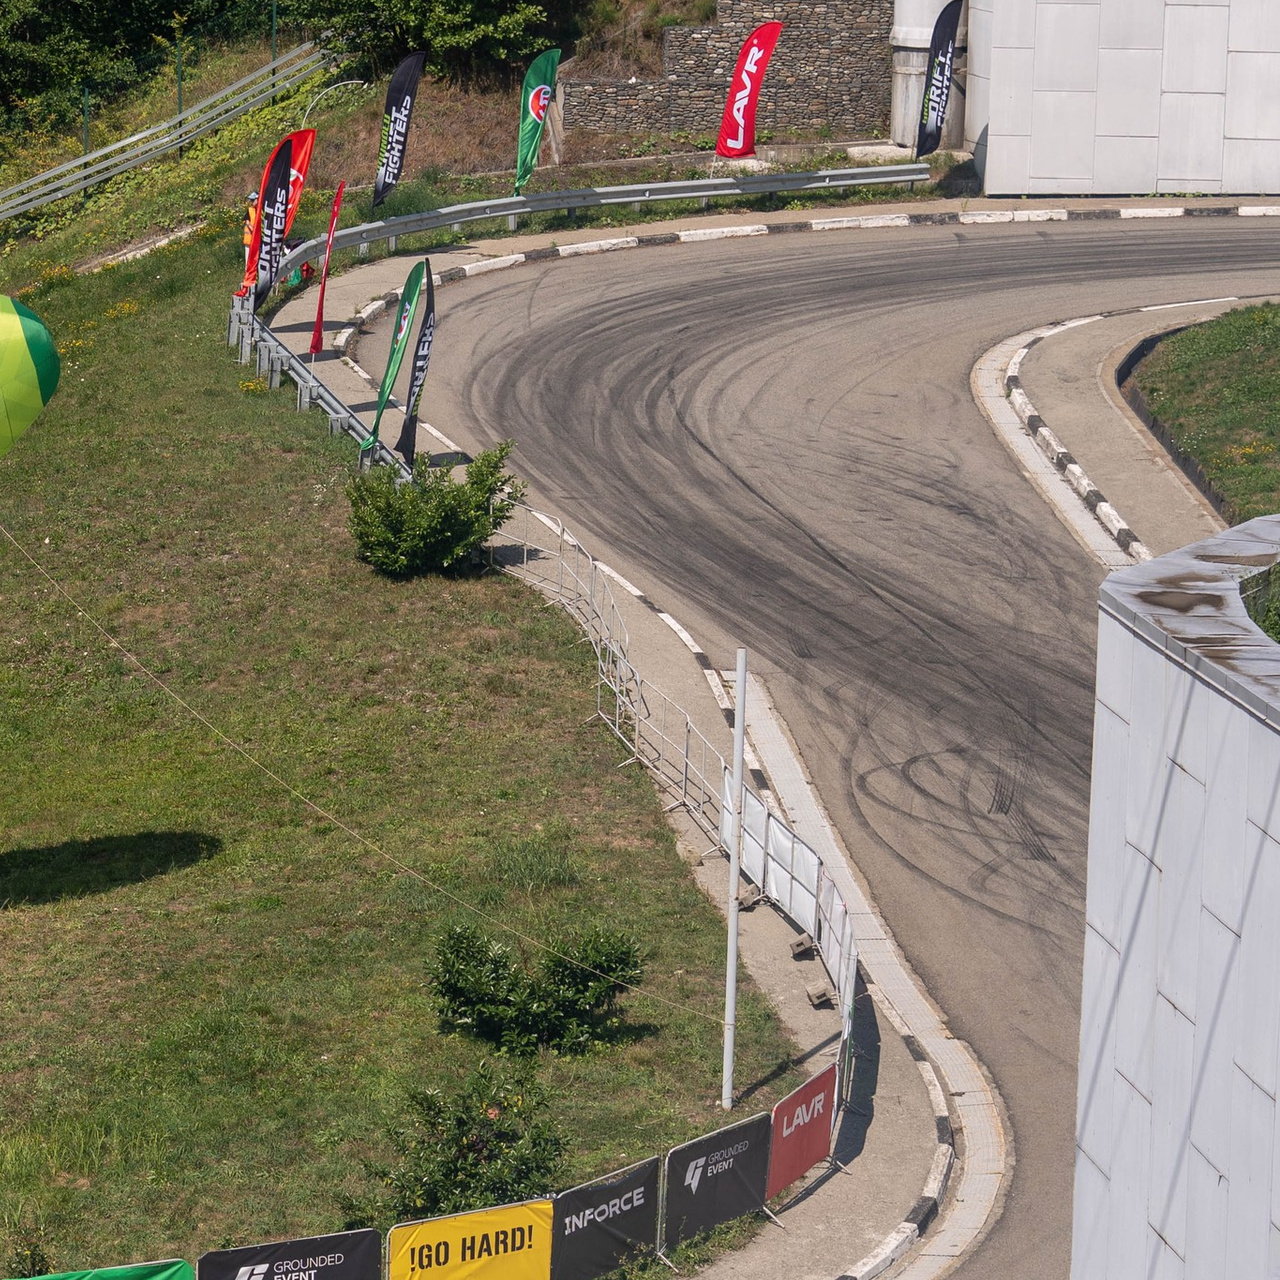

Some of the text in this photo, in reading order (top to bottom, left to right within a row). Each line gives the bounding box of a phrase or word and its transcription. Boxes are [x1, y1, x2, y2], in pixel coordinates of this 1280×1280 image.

[384, 95, 411, 185] FIGHTERS
[707, 1158, 734, 1177] EVENT
[708, 1140, 749, 1164] GROUNDED
[564, 1186, 645, 1236] INFORCE
[273, 1253, 345, 1274] GROUNDED
[410, 1224, 534, 1272] !GO HARD!
